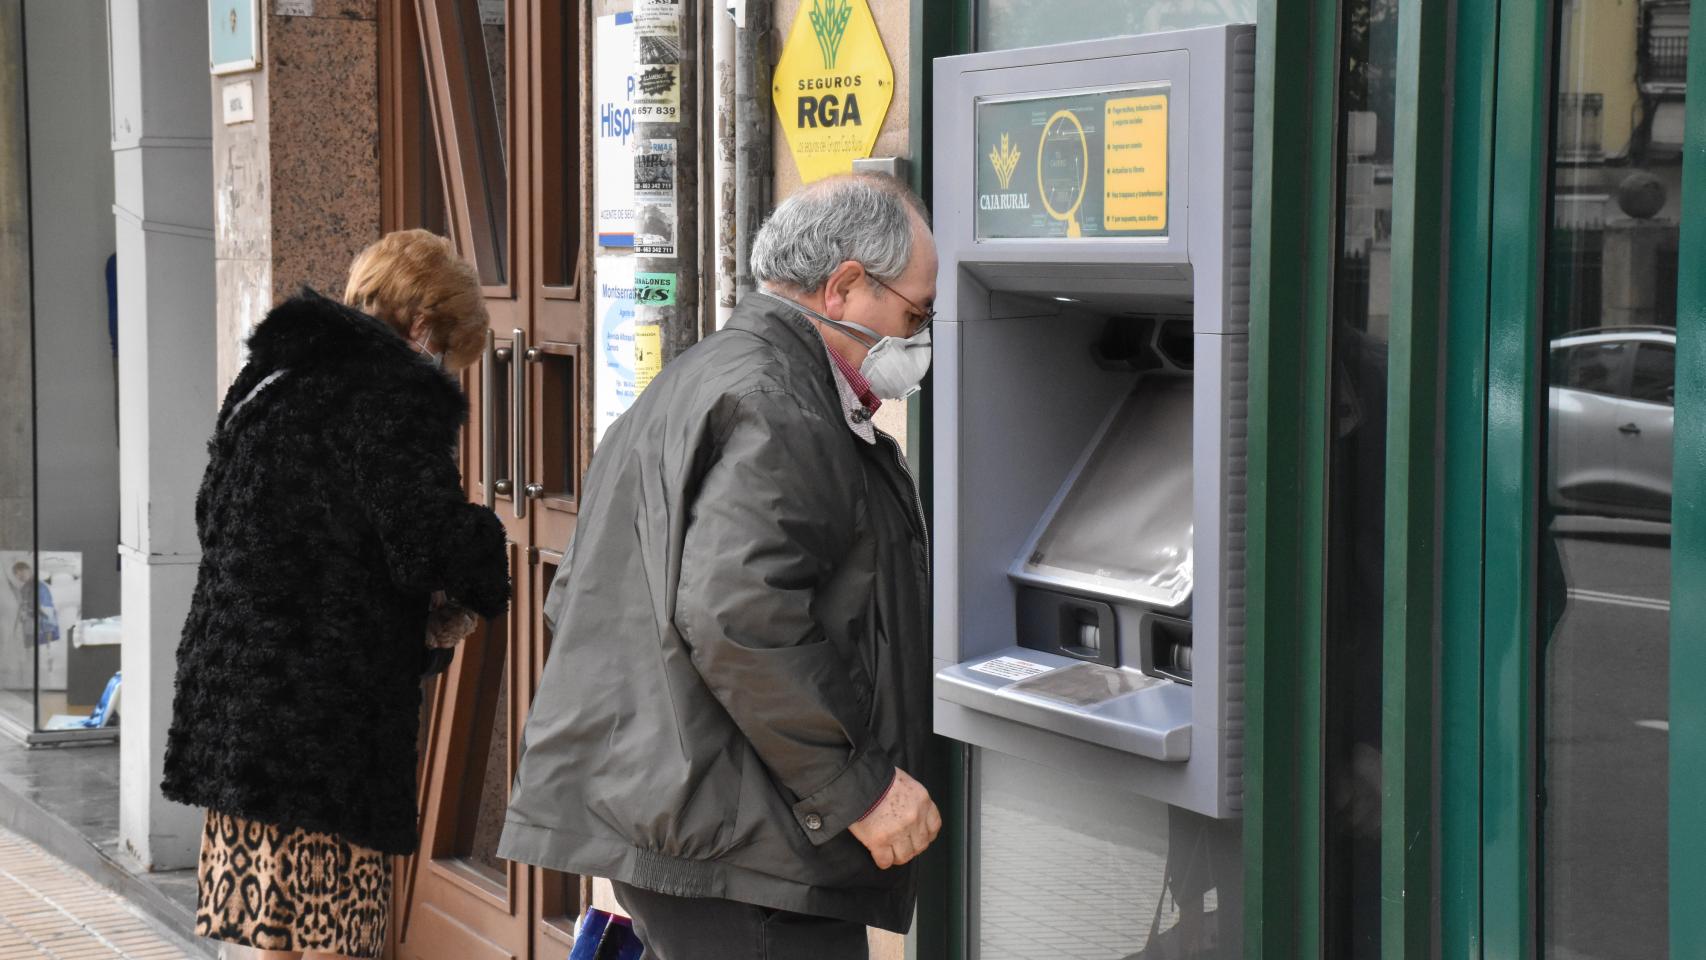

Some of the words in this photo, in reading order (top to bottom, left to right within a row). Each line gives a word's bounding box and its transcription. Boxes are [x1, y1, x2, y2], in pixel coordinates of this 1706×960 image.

[798, 76, 862, 90] SEGUROS
[656, 106, 676, 115] 839
[798, 93, 862, 128] RGA
[980, 194, 1001, 210] CAJA
[1001, 192, 1030, 210] RURAL
